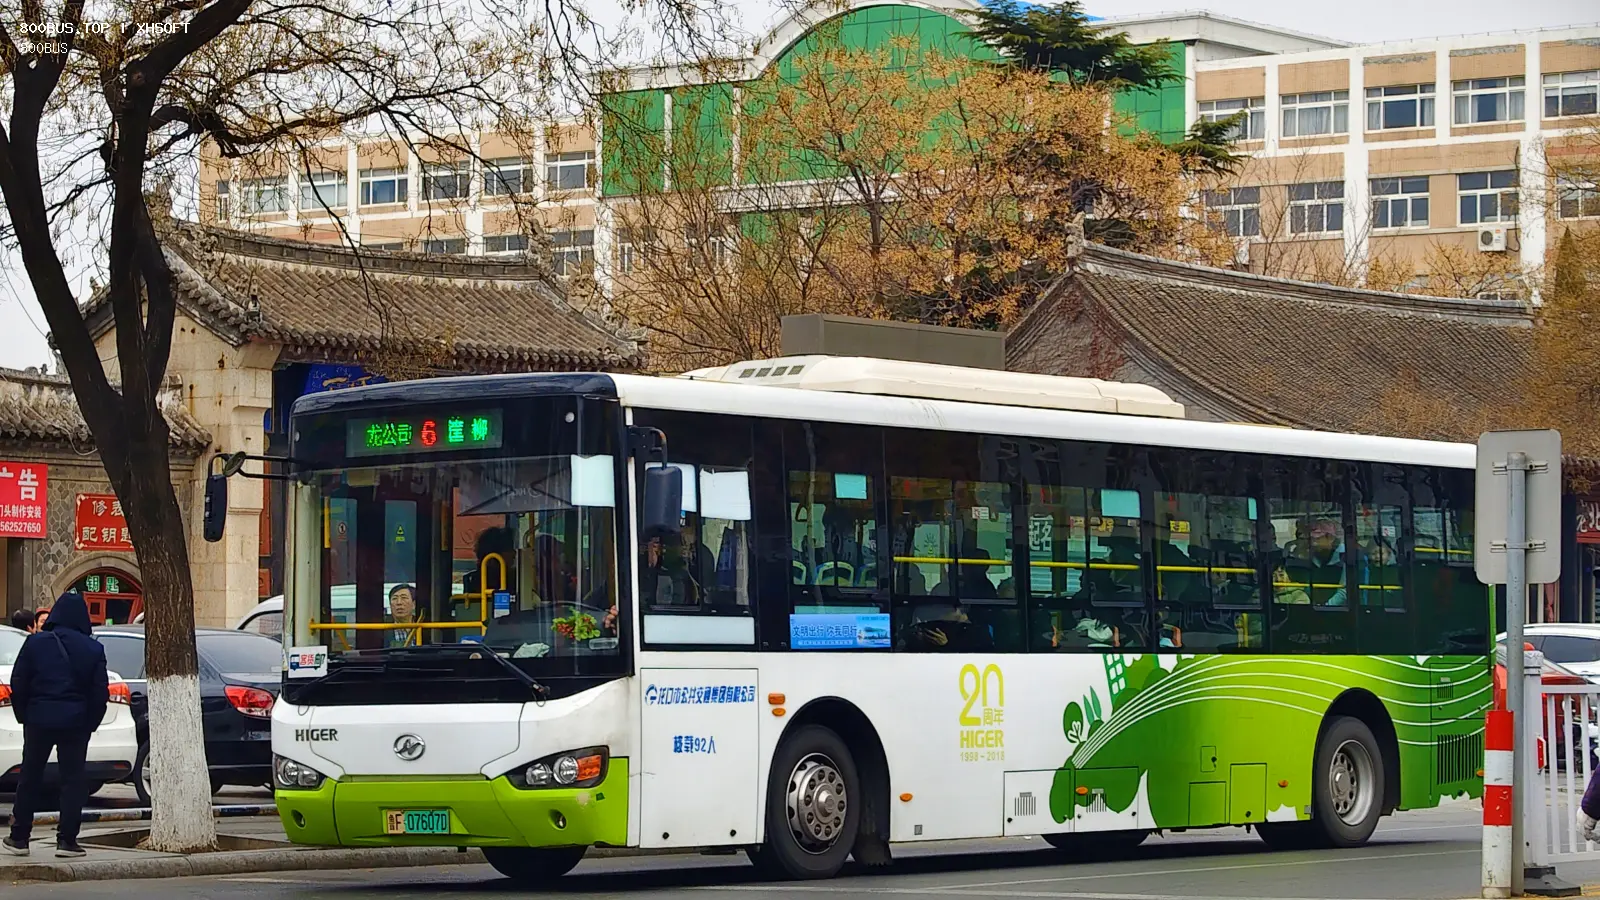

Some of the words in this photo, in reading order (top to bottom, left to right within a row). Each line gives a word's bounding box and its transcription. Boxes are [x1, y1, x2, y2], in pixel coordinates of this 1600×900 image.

[420, 420, 437, 446] 6
[295, 728, 339, 742] HIGER
[960, 730, 1004, 748] HIGER
